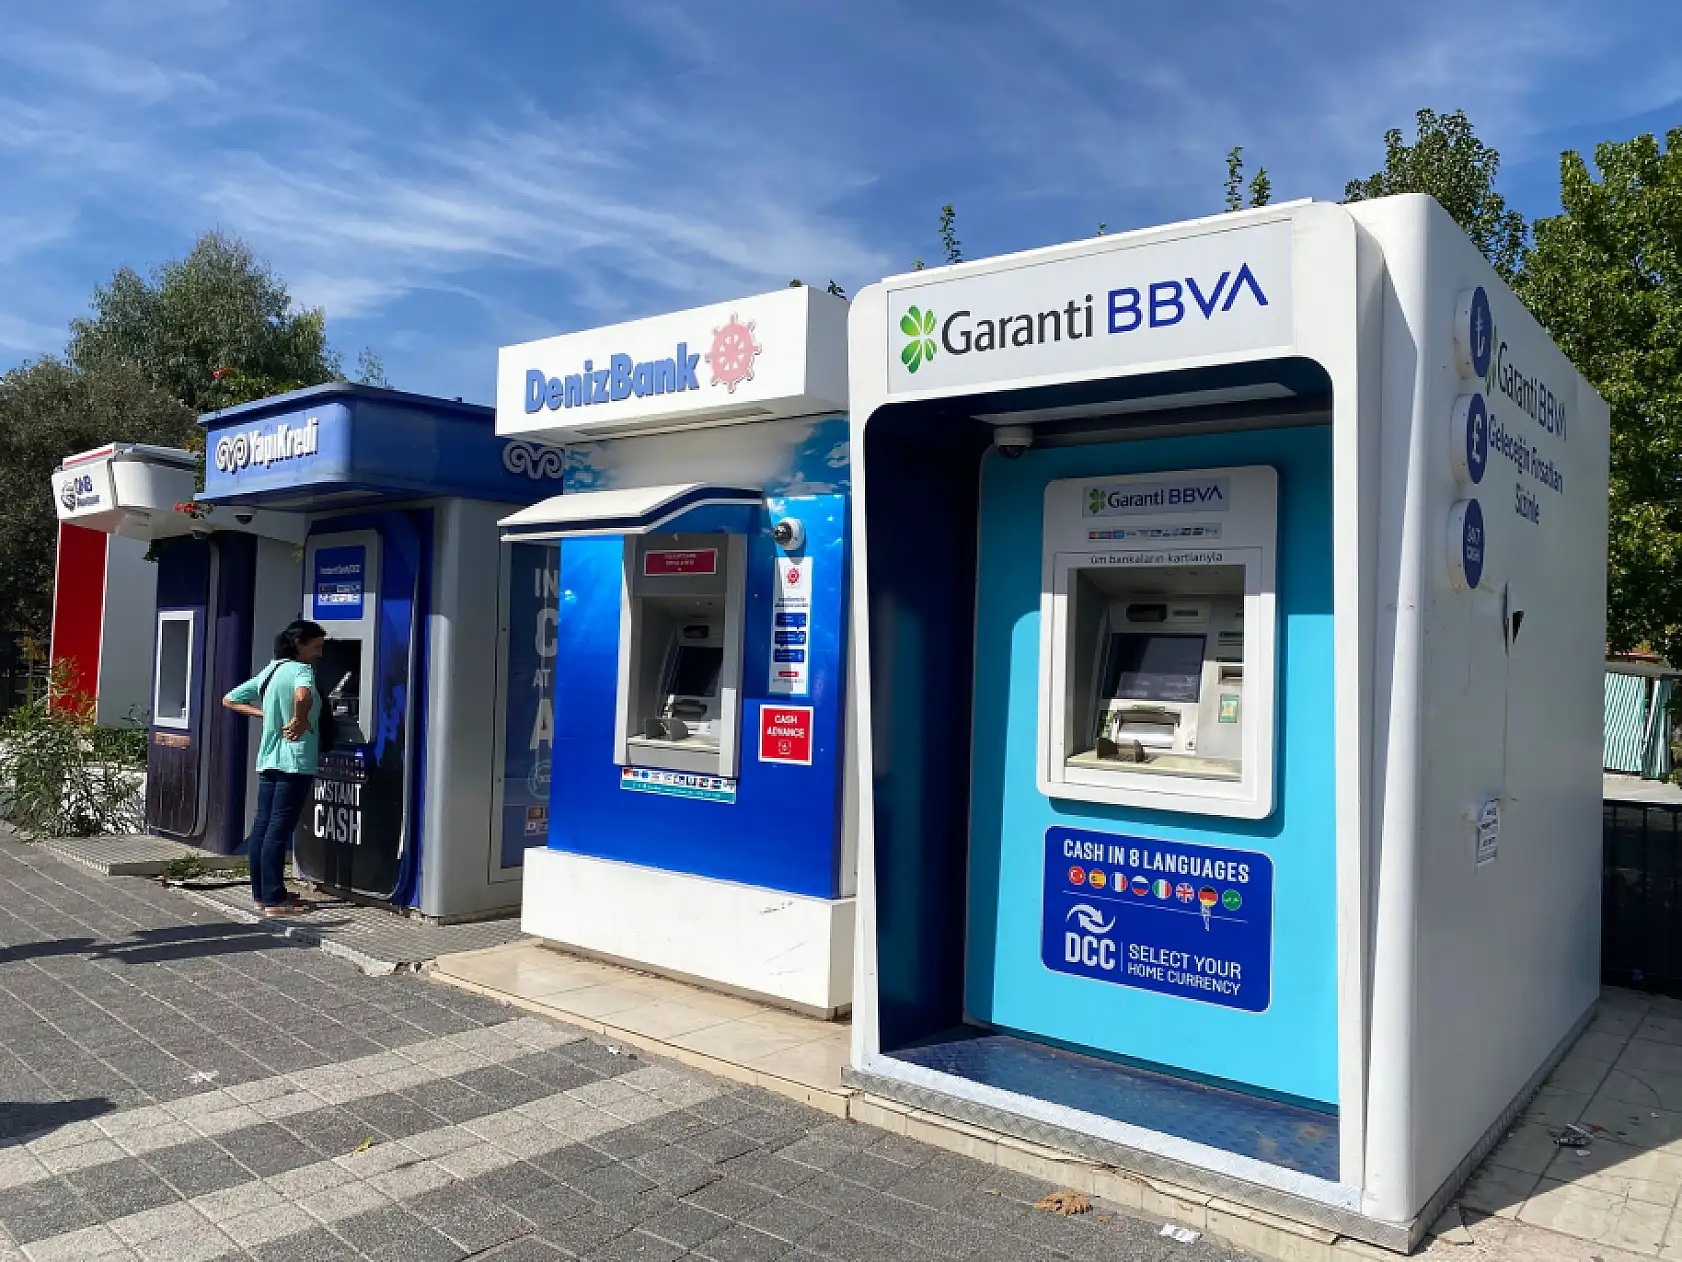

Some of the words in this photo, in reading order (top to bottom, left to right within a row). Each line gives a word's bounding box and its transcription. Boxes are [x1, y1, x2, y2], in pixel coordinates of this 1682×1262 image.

[942, 294, 1094, 355] Garanti
[1108, 262, 1269, 335] BBVA
[525, 342, 700, 414] DenizBank
[1497, 341, 1537, 420] Garanti
[1108, 489, 1164, 508] Garanti
[1168, 484, 1223, 504] BBVA
[767, 726, 805, 739] ADVANCE
[774, 714, 798, 725] CASH
[314, 778, 362, 807] INSTANT
[314, 803, 362, 845] CASH
[1063, 838, 1104, 862] CASH
[1108, 845, 1125, 866] IN
[1129, 848, 1140, 867] 8
[1143, 850, 1250, 884] LANGUAGES
[1064, 931, 1117, 971] DCC
[1128, 943, 1190, 970] SELECT
[1194, 954, 1242, 980] YOUR
[1127, 962, 1164, 982] HOME
[1167, 968, 1241, 996] CURRENCY
